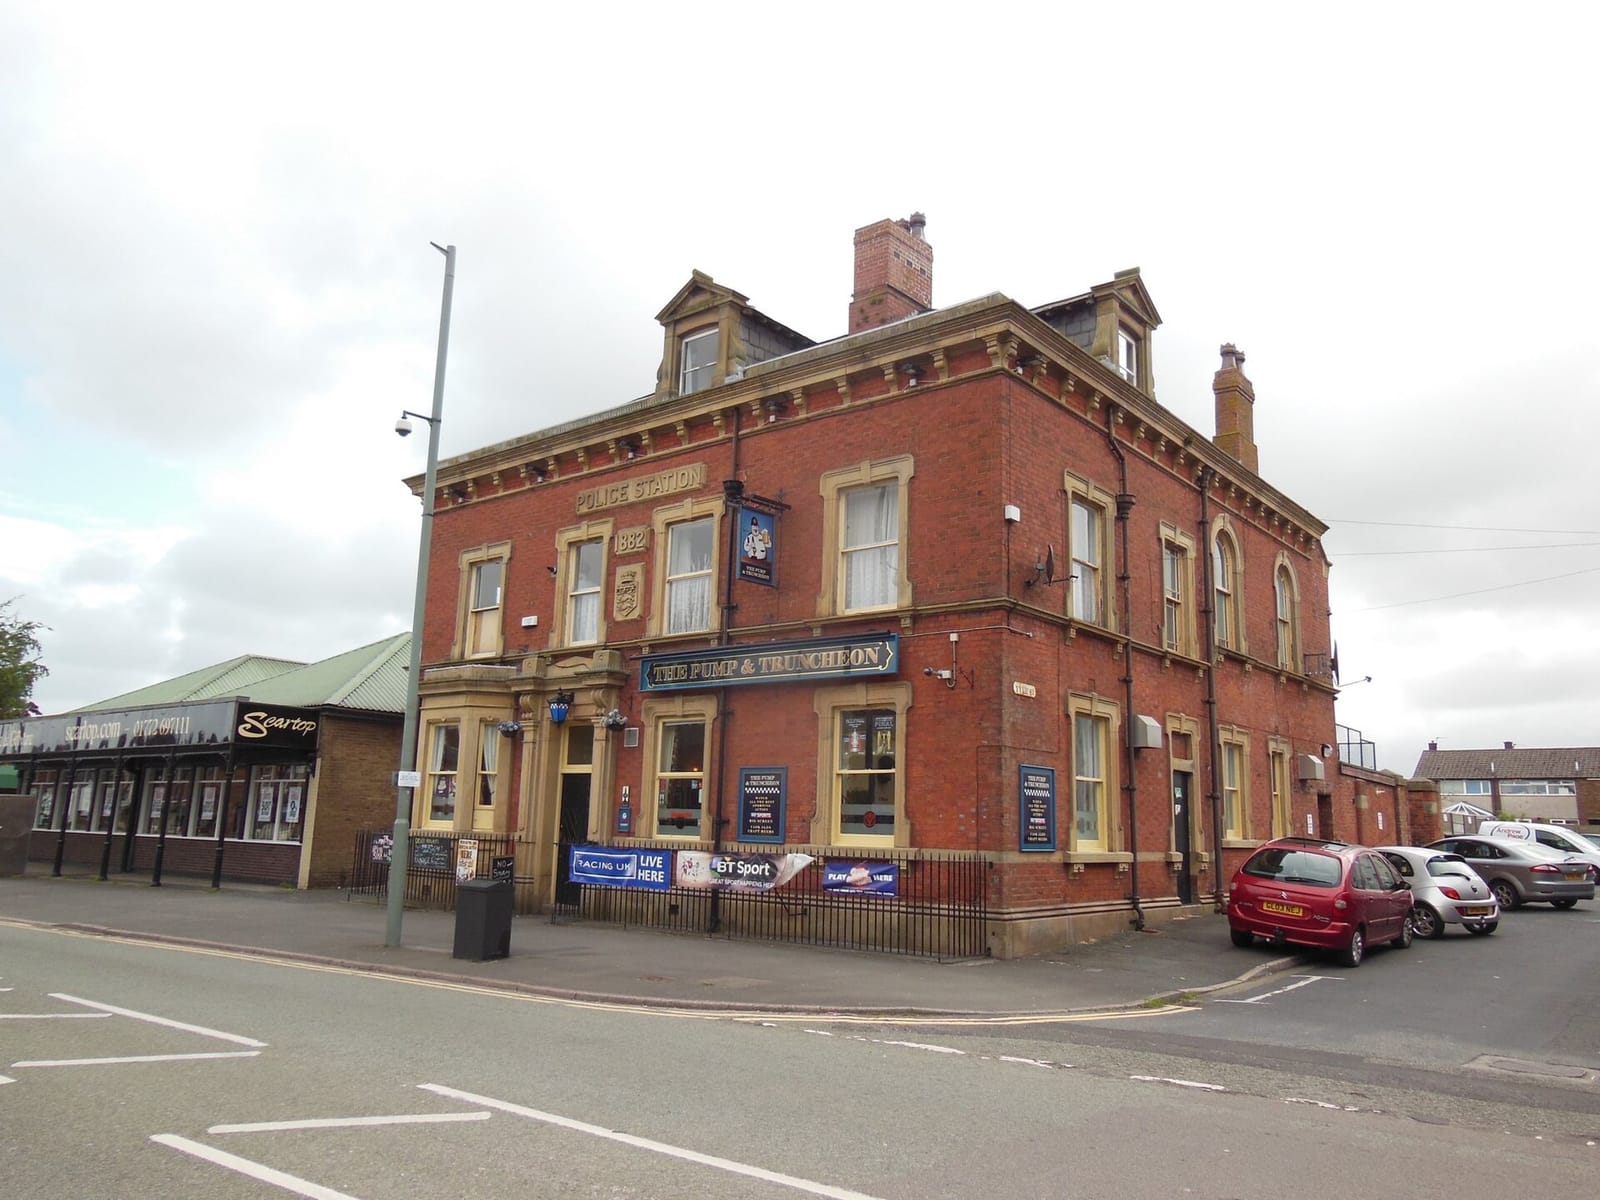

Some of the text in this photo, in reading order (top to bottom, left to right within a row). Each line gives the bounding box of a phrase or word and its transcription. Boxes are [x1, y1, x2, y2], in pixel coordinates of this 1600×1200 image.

[576, 467, 702, 509] POLICE STATION
[615, 530, 646, 553] 1882
[654, 646, 881, 683] THE PUMP & TRUNCHEON
[578, 859, 631, 871] RACING UK
[640, 855, 663, 868] LIVE
[717, 861, 771, 876] BT Sport
[638, 869, 665, 883] HERE
[828, 873, 848, 881] PLAY
